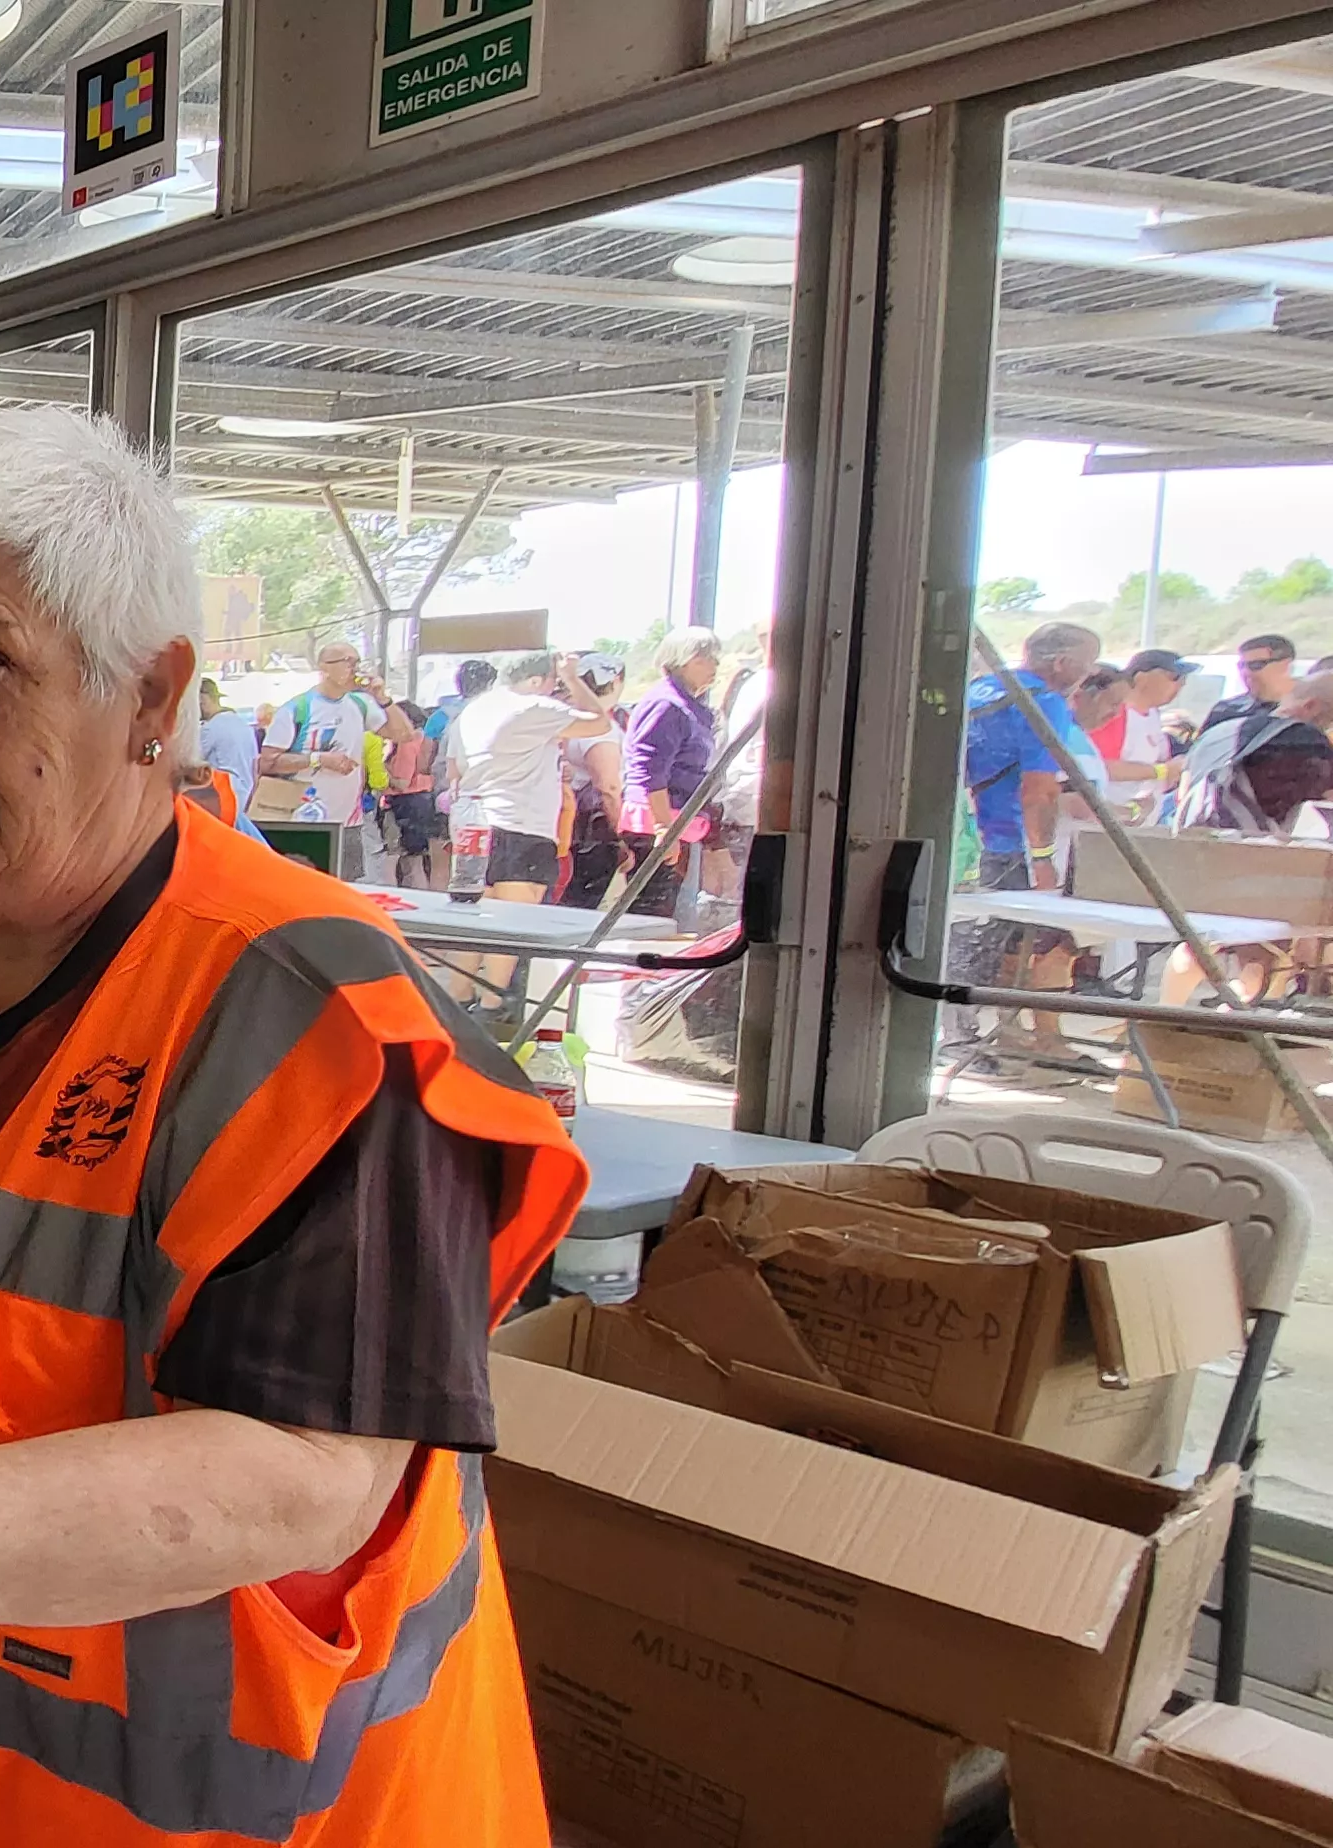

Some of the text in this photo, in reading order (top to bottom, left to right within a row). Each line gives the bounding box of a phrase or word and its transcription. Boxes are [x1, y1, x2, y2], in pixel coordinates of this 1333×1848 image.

[384, 60, 523, 121] EMERGENCIA
[397, 36, 514, 91] SALIDA DE
[632, 1628, 764, 1710] MUJER
